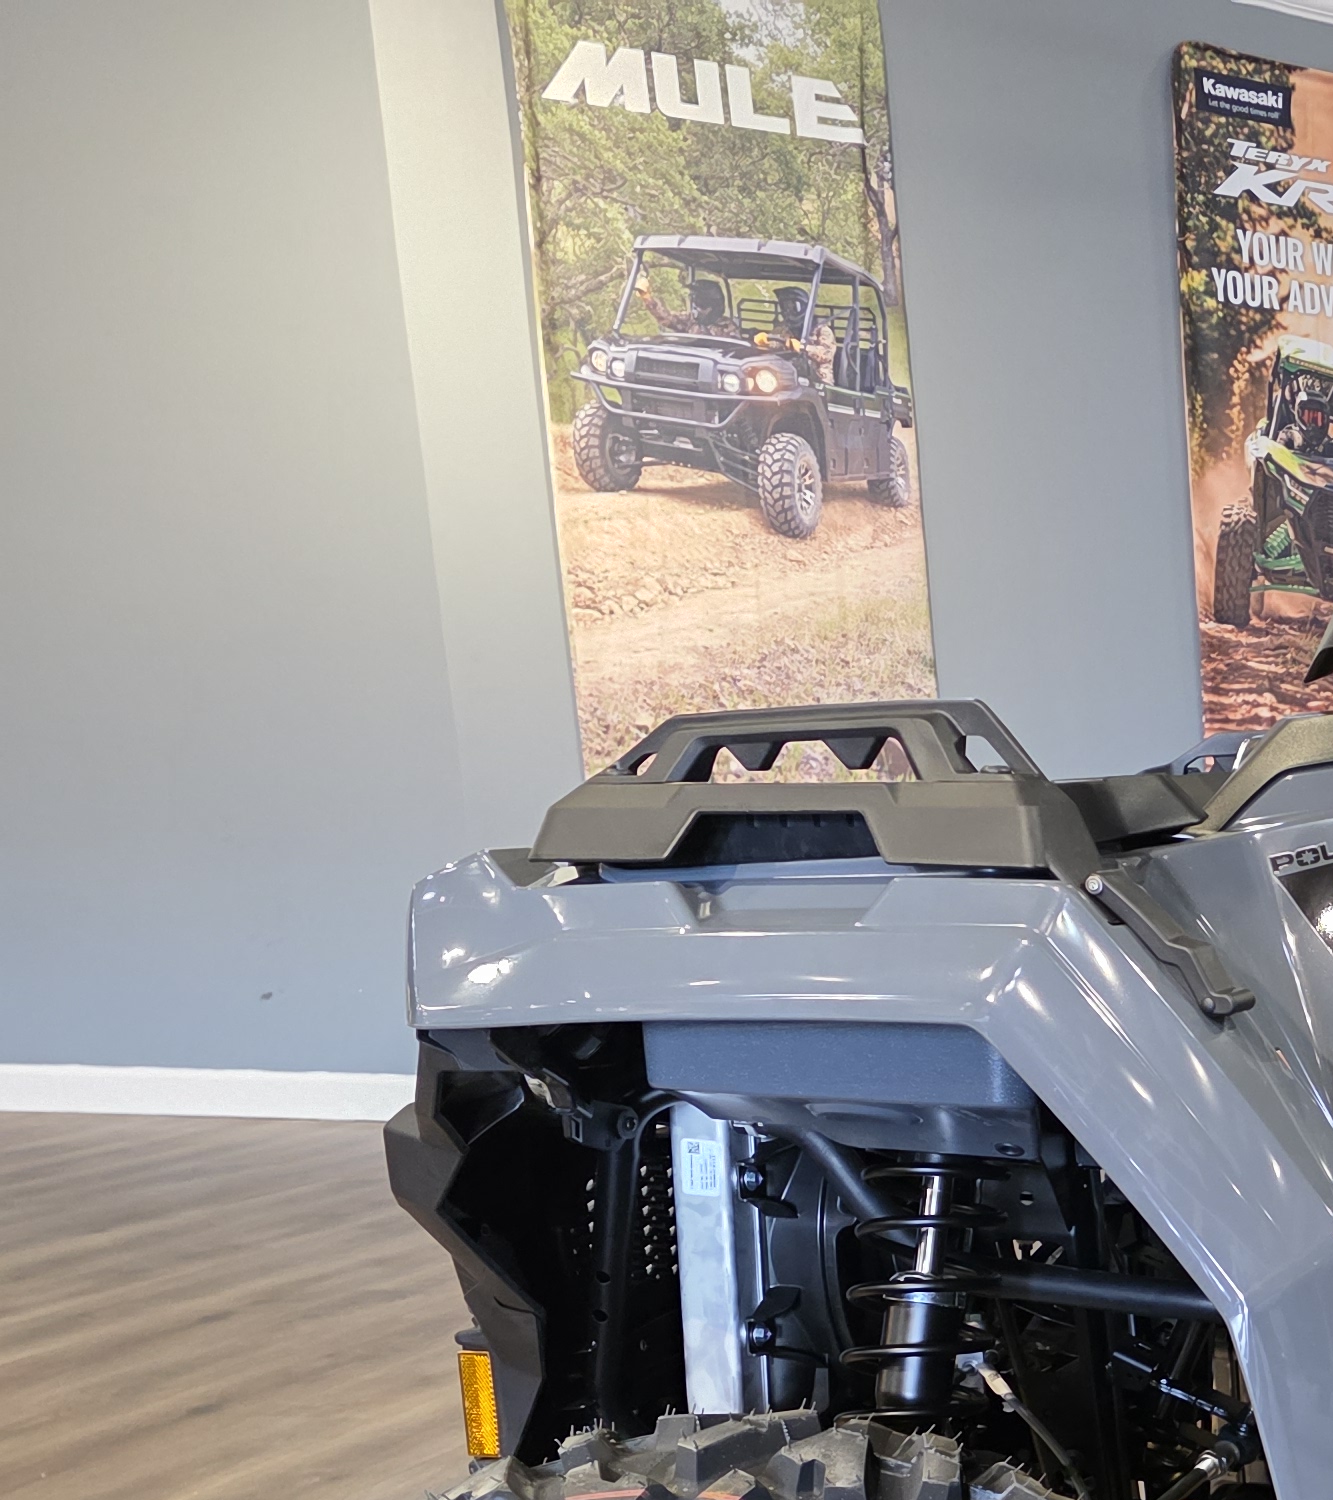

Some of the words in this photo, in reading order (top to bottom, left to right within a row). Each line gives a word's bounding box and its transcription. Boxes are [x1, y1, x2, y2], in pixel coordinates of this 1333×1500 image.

[541, 39, 865, 145] MULE
[1203, 77, 1283, 108] Kawasaki
[1208, 98, 1218, 107] Let
[1232, 104, 1248, 114] good
[1236, 229, 1304, 268] YOUR
[1211, 267, 1280, 311] YOUR
